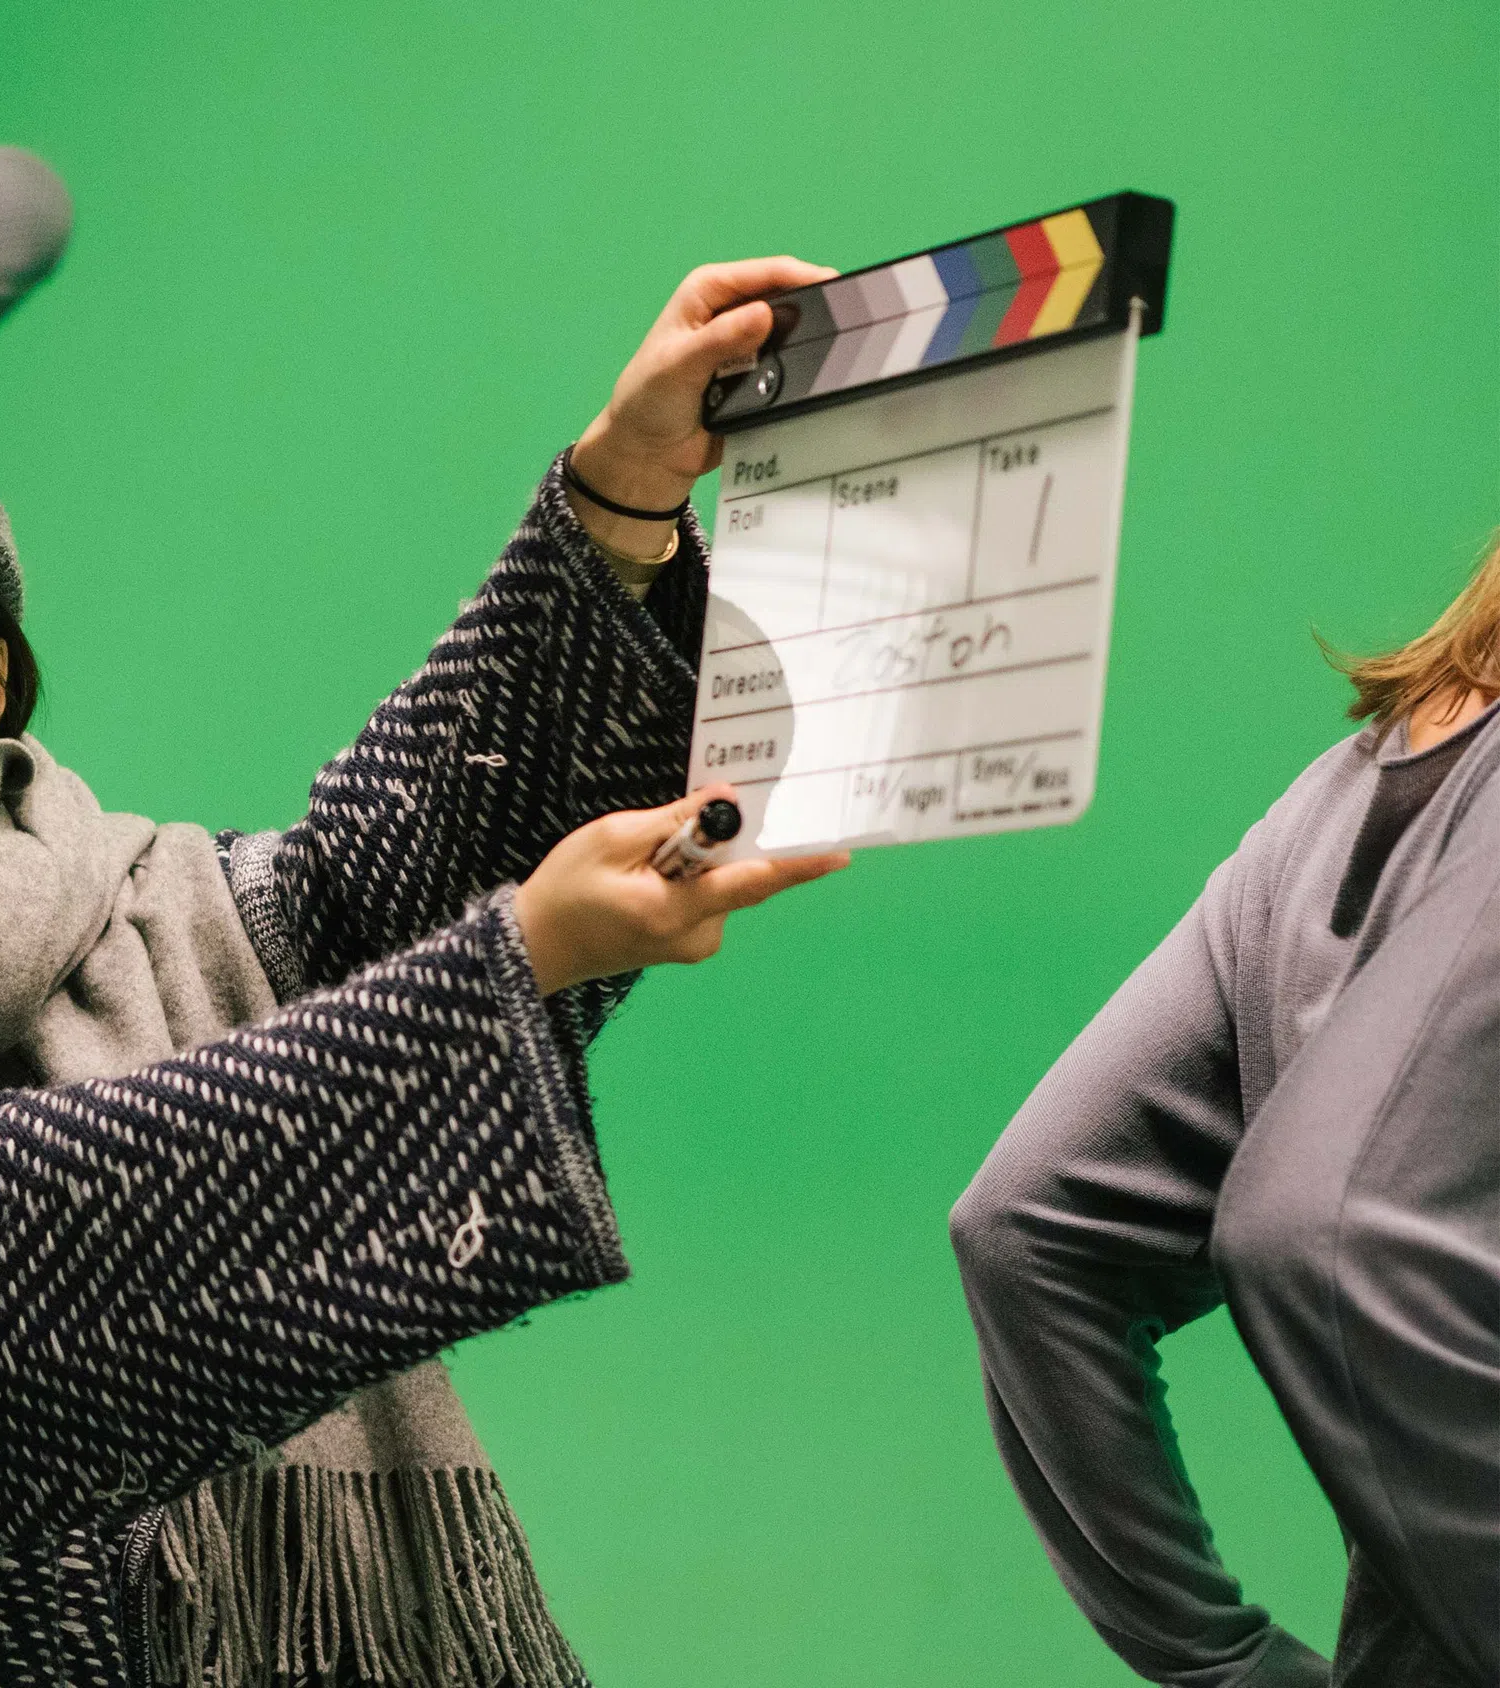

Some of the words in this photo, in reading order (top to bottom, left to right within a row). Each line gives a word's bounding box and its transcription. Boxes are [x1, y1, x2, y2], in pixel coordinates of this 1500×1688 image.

[733, 454, 781, 485] Prod.
[989, 443, 1040, 473] Take
[837, 476, 899, 508] Scene
[728, 504, 764, 533] Roll
[711, 668, 784, 699] Director
[704, 739, 777, 767] Camera
